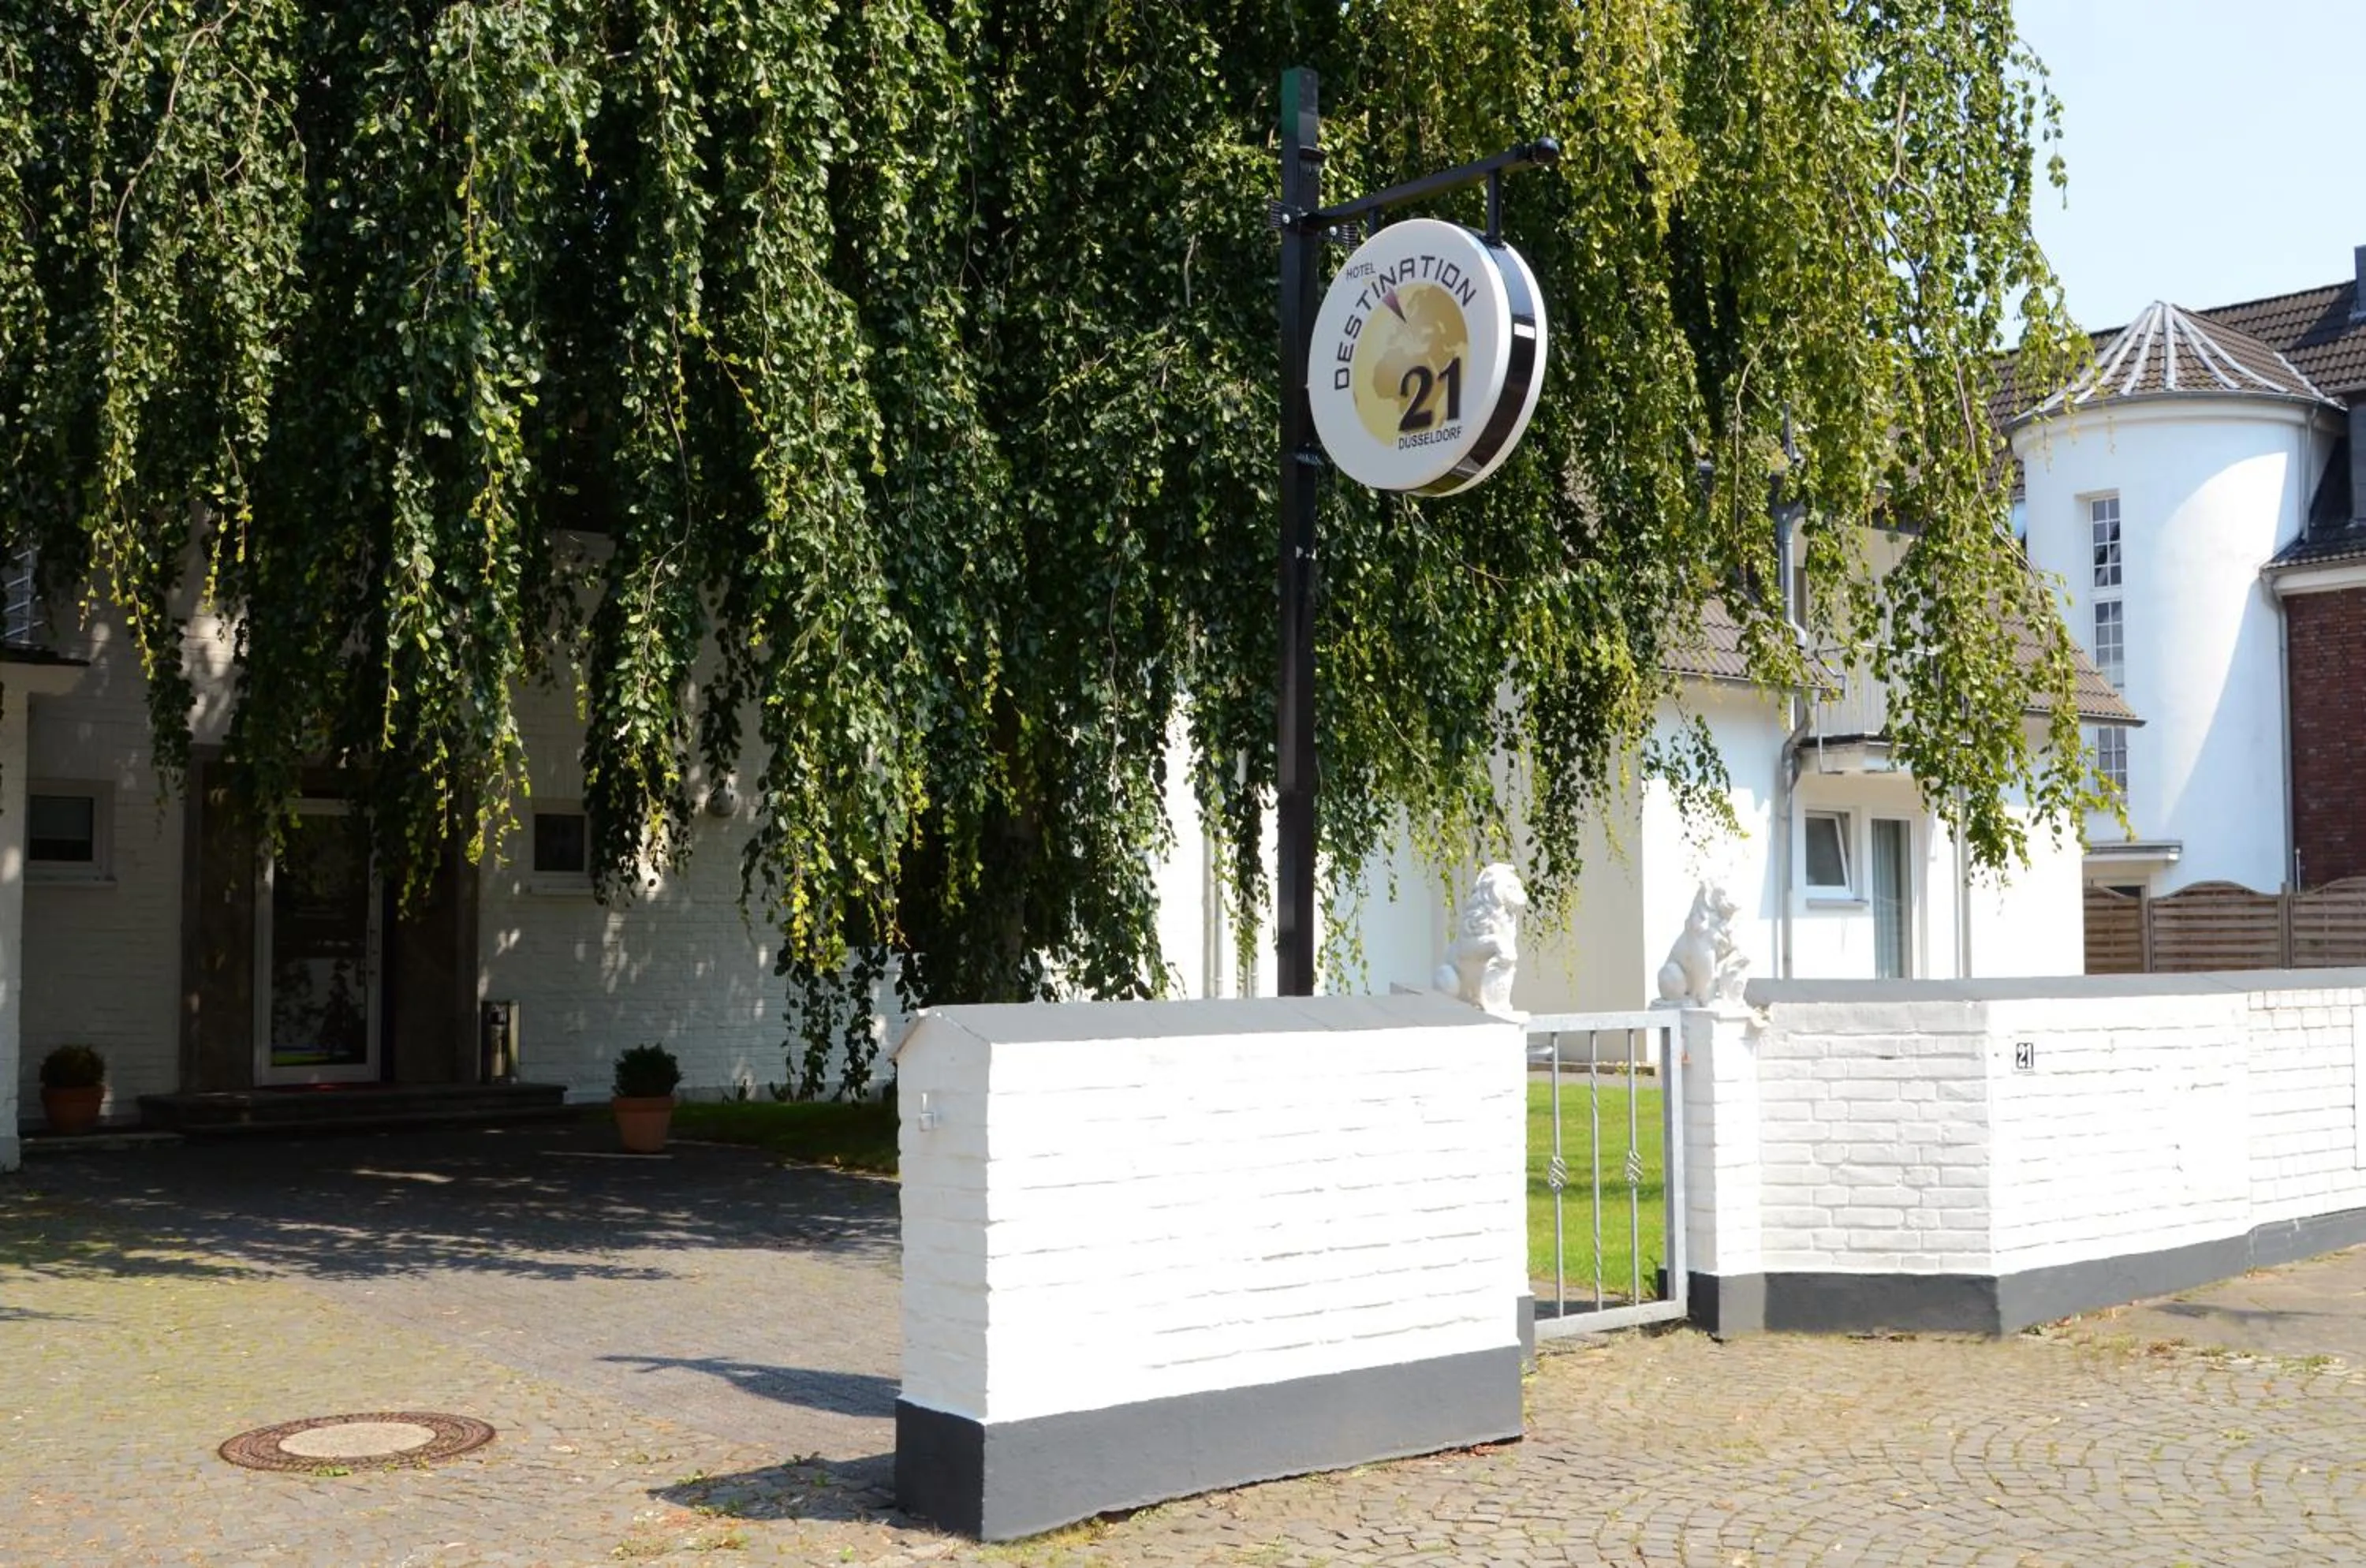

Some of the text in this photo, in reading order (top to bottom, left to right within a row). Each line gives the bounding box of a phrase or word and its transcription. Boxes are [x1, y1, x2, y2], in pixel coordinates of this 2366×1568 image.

[1346, 262, 1376, 279] HOTEL
[1334, 255, 1476, 390] DESTINATION
[1398, 357, 1461, 431] 21
[2017, 1043, 2032, 1067] 21
